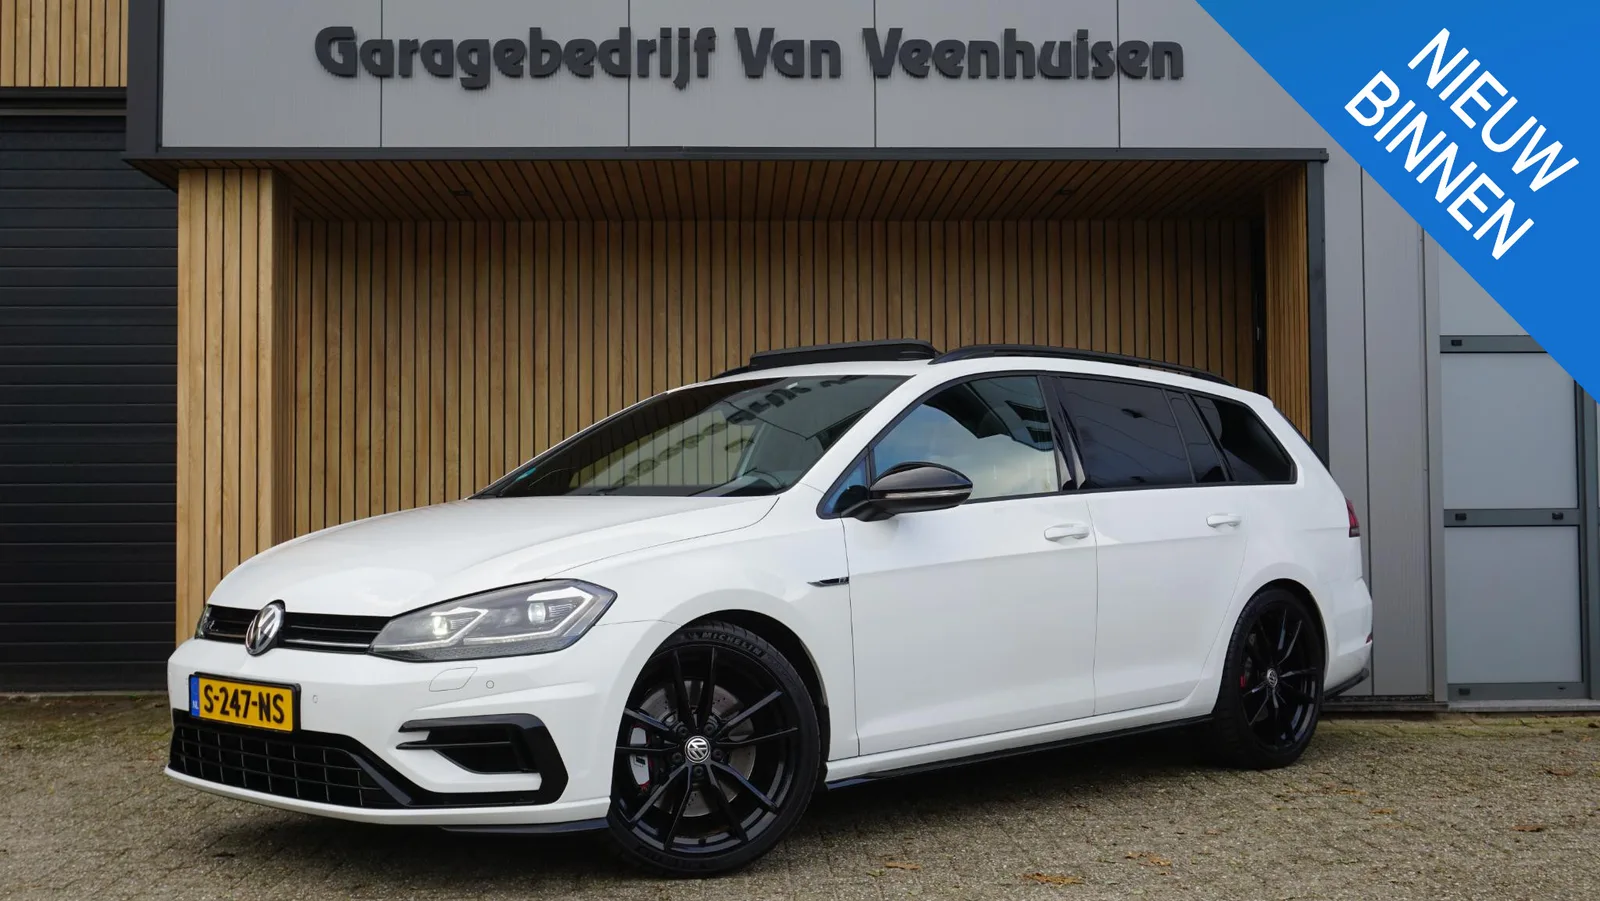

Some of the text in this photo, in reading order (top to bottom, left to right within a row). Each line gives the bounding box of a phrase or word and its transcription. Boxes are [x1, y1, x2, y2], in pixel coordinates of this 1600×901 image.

[314, 26, 1184, 89] Garagebedrijf Van Veenhuisen
[701, 631, 763, 658] MICHELIN
[203, 683, 285, 724] S-247-NS
